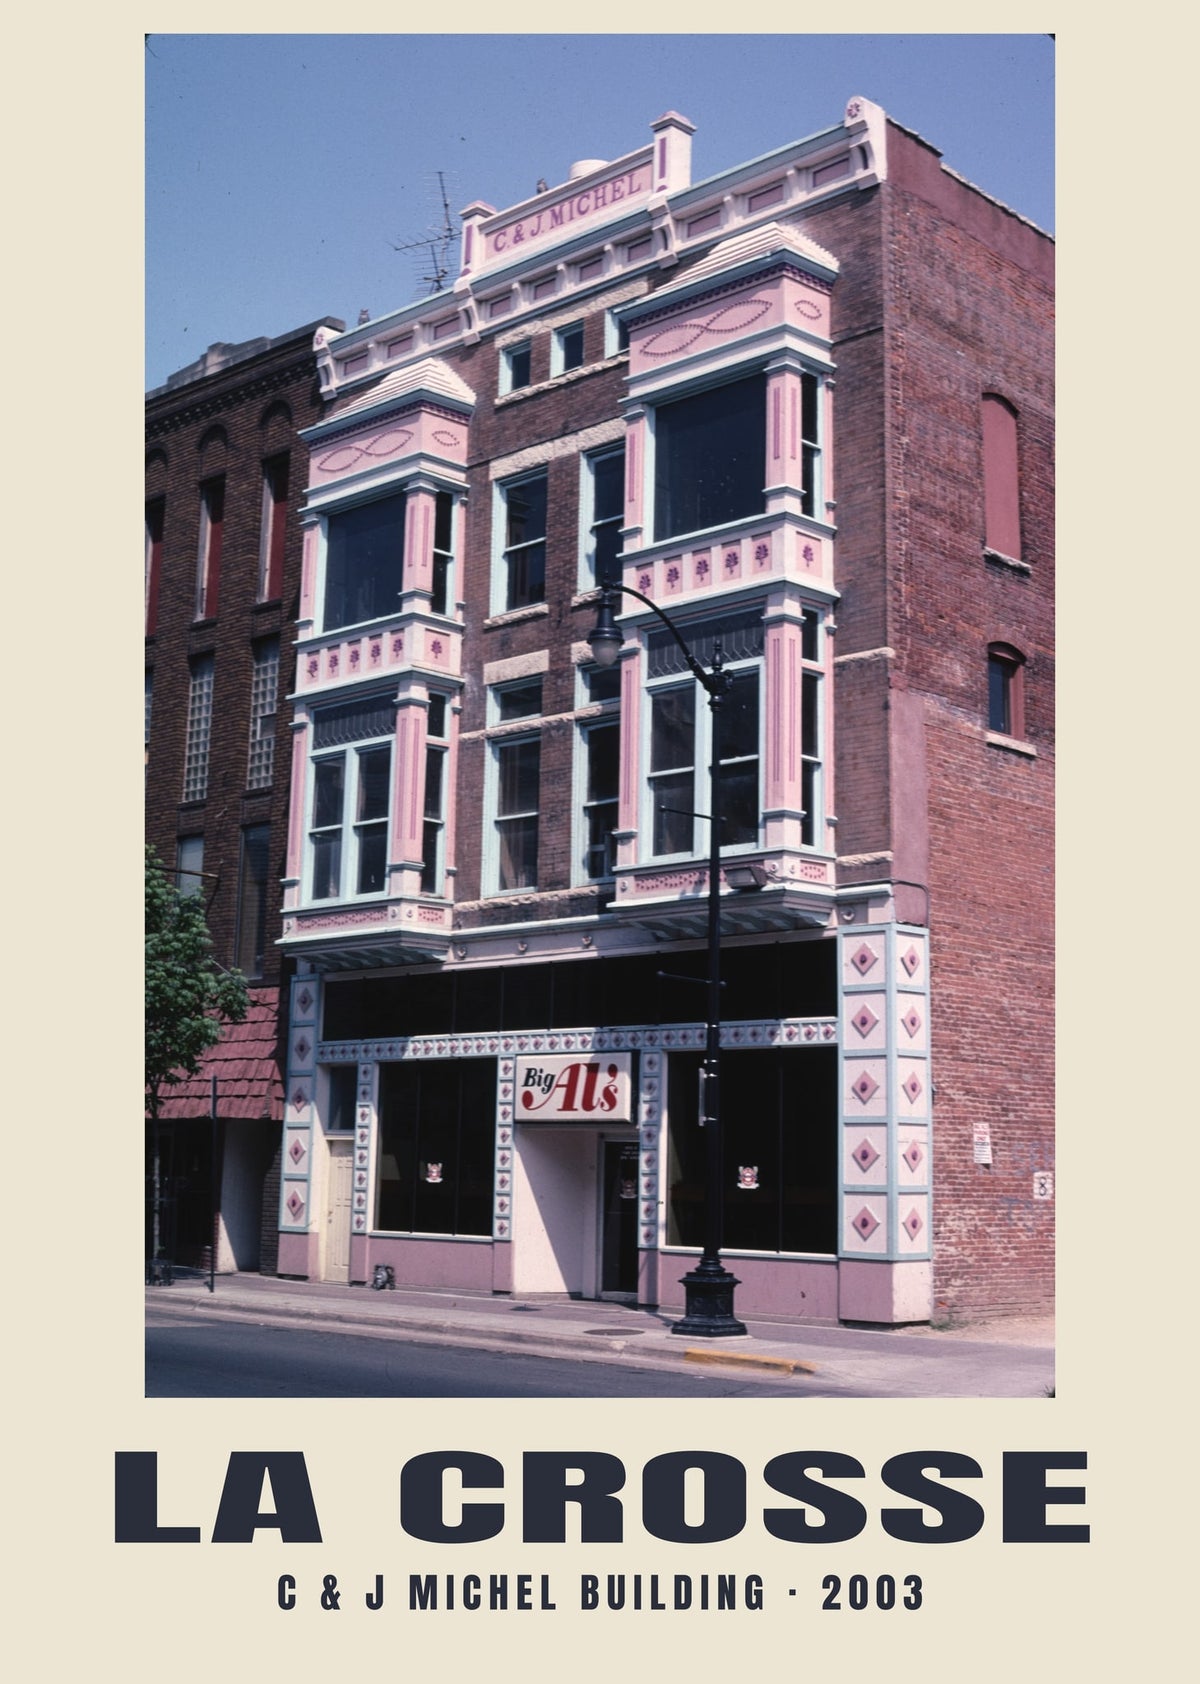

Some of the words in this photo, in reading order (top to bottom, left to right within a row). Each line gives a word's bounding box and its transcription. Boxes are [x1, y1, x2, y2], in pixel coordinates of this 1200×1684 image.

[513, 223, 524, 245] &
[550, 173, 641, 229] MICHEL
[521, 1067, 557, 1095] Big
[521, 1062, 619, 1112] Al's
[1039, 1176, 1047, 1197] 8
